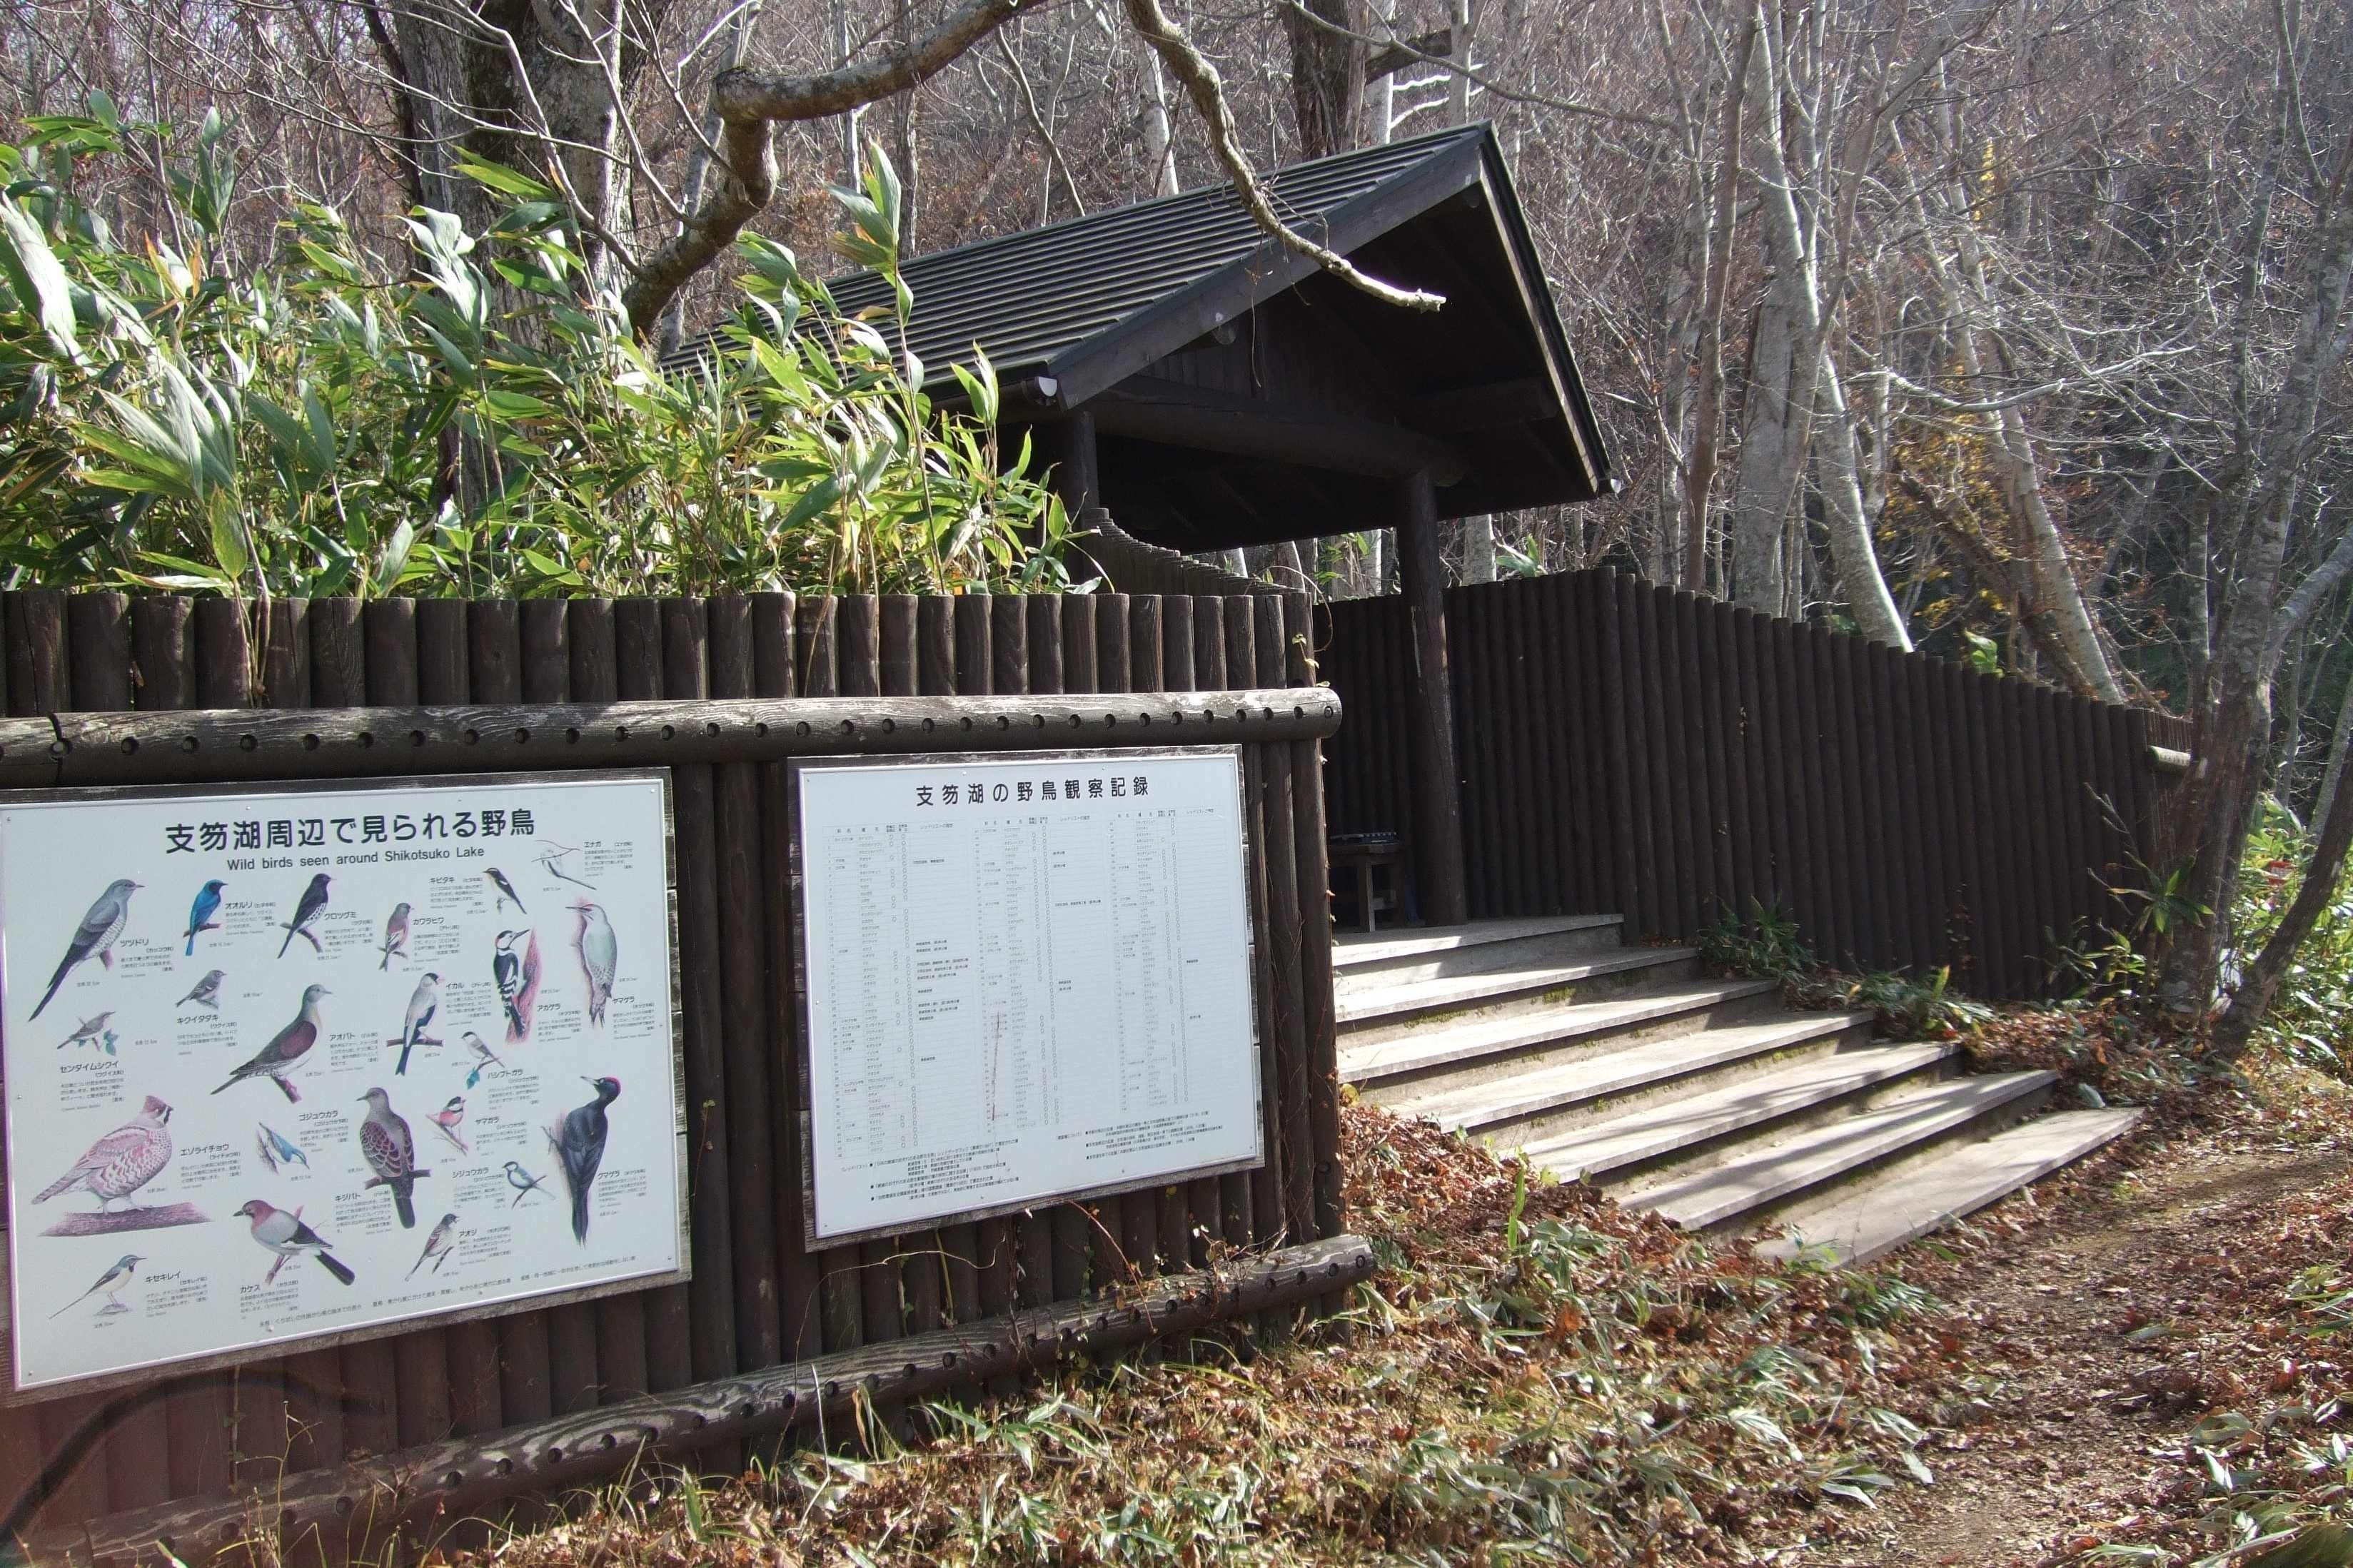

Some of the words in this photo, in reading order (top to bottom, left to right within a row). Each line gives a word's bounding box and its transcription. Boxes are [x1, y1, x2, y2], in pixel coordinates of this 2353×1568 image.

[916, 777, 1149, 807] 支笏湖の野鳥観察記録
[166, 809, 535, 854] 支笏湖周辺で見られる野鳥
[227, 859, 255, 871] Wild
[262, 856, 293, 869] birds
[300, 856, 329, 866] seen
[336, 853, 378, 864] around
[385, 848, 450, 862] Shikotsuko
[456, 846, 485, 857] Lake
[225, 901, 252, 910] オオルリ
[324, 911, 357, 921] クロツグミ
[413, 917, 444, 926] カワラヒワ
[120, 939, 149, 948] ツツドリ
[537, 1003, 561, 1012] アカゲラ
[177, 1014, 218, 1025] キクイタダキ
[145, 1272, 181, 1283] キセキレイ
[239, 1285, 261, 1294] カケス
